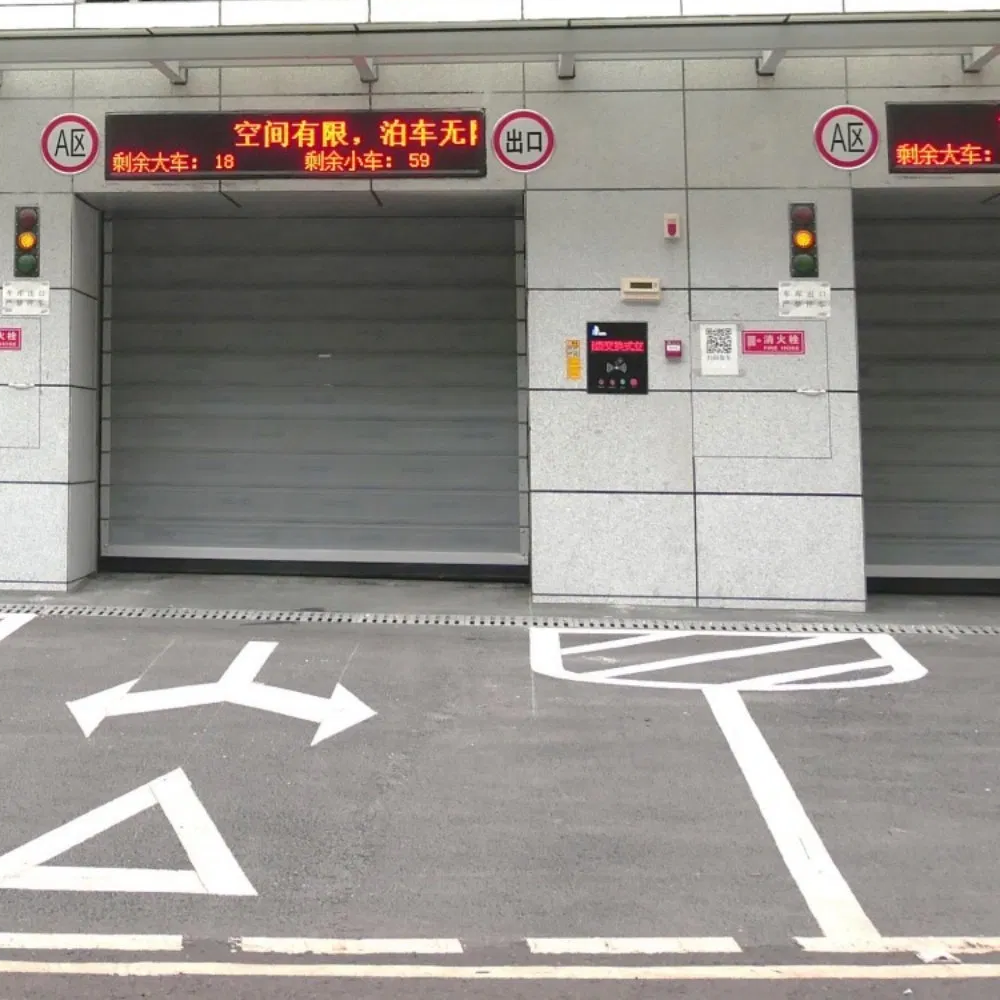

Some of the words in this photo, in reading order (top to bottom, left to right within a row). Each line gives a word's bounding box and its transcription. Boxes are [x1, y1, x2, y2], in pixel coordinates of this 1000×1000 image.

[55, 127, 86, 157] A区
[506, 128, 543, 154] 出口
[831, 121, 864, 153] A区
[215, 154, 235, 169] 18
[409, 152, 430, 168] 59
[763, 334, 800, 345] 消火栓
